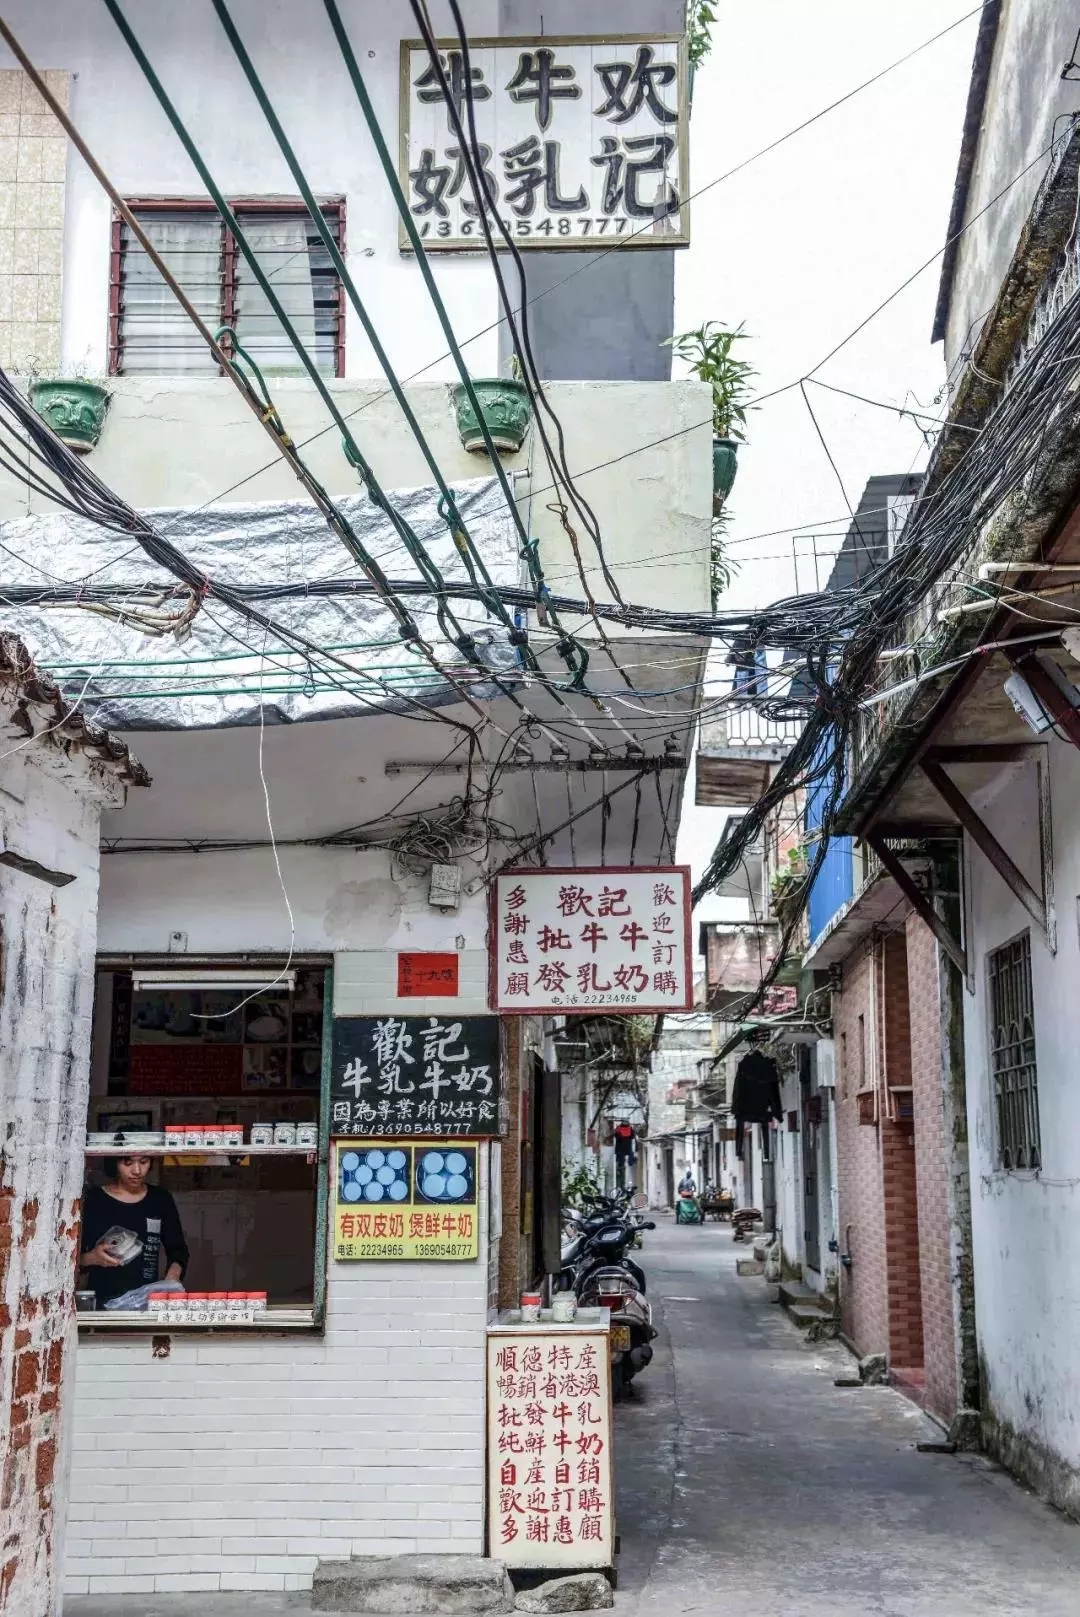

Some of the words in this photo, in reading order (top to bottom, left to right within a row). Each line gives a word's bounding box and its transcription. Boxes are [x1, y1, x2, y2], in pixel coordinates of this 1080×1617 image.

[556, 884, 632, 918] 歡記
[651, 883, 679, 996] 歡迎訂購
[369, 1017, 470, 1068] 歡記
[341, 1056, 494, 1100] 牛乳牛奶
[340, 1212, 404, 1239] 有双皮奶
[409, 1212, 473, 1239] 煲鲜牛奶
[415, 1244, 473, 1256] 13690548777
[497, 1400, 602, 1428] 批發牛乳
[498, 1486, 606, 1515] 歡迎訂購
[500, 1514, 604, 1545] 多謝惠顧
